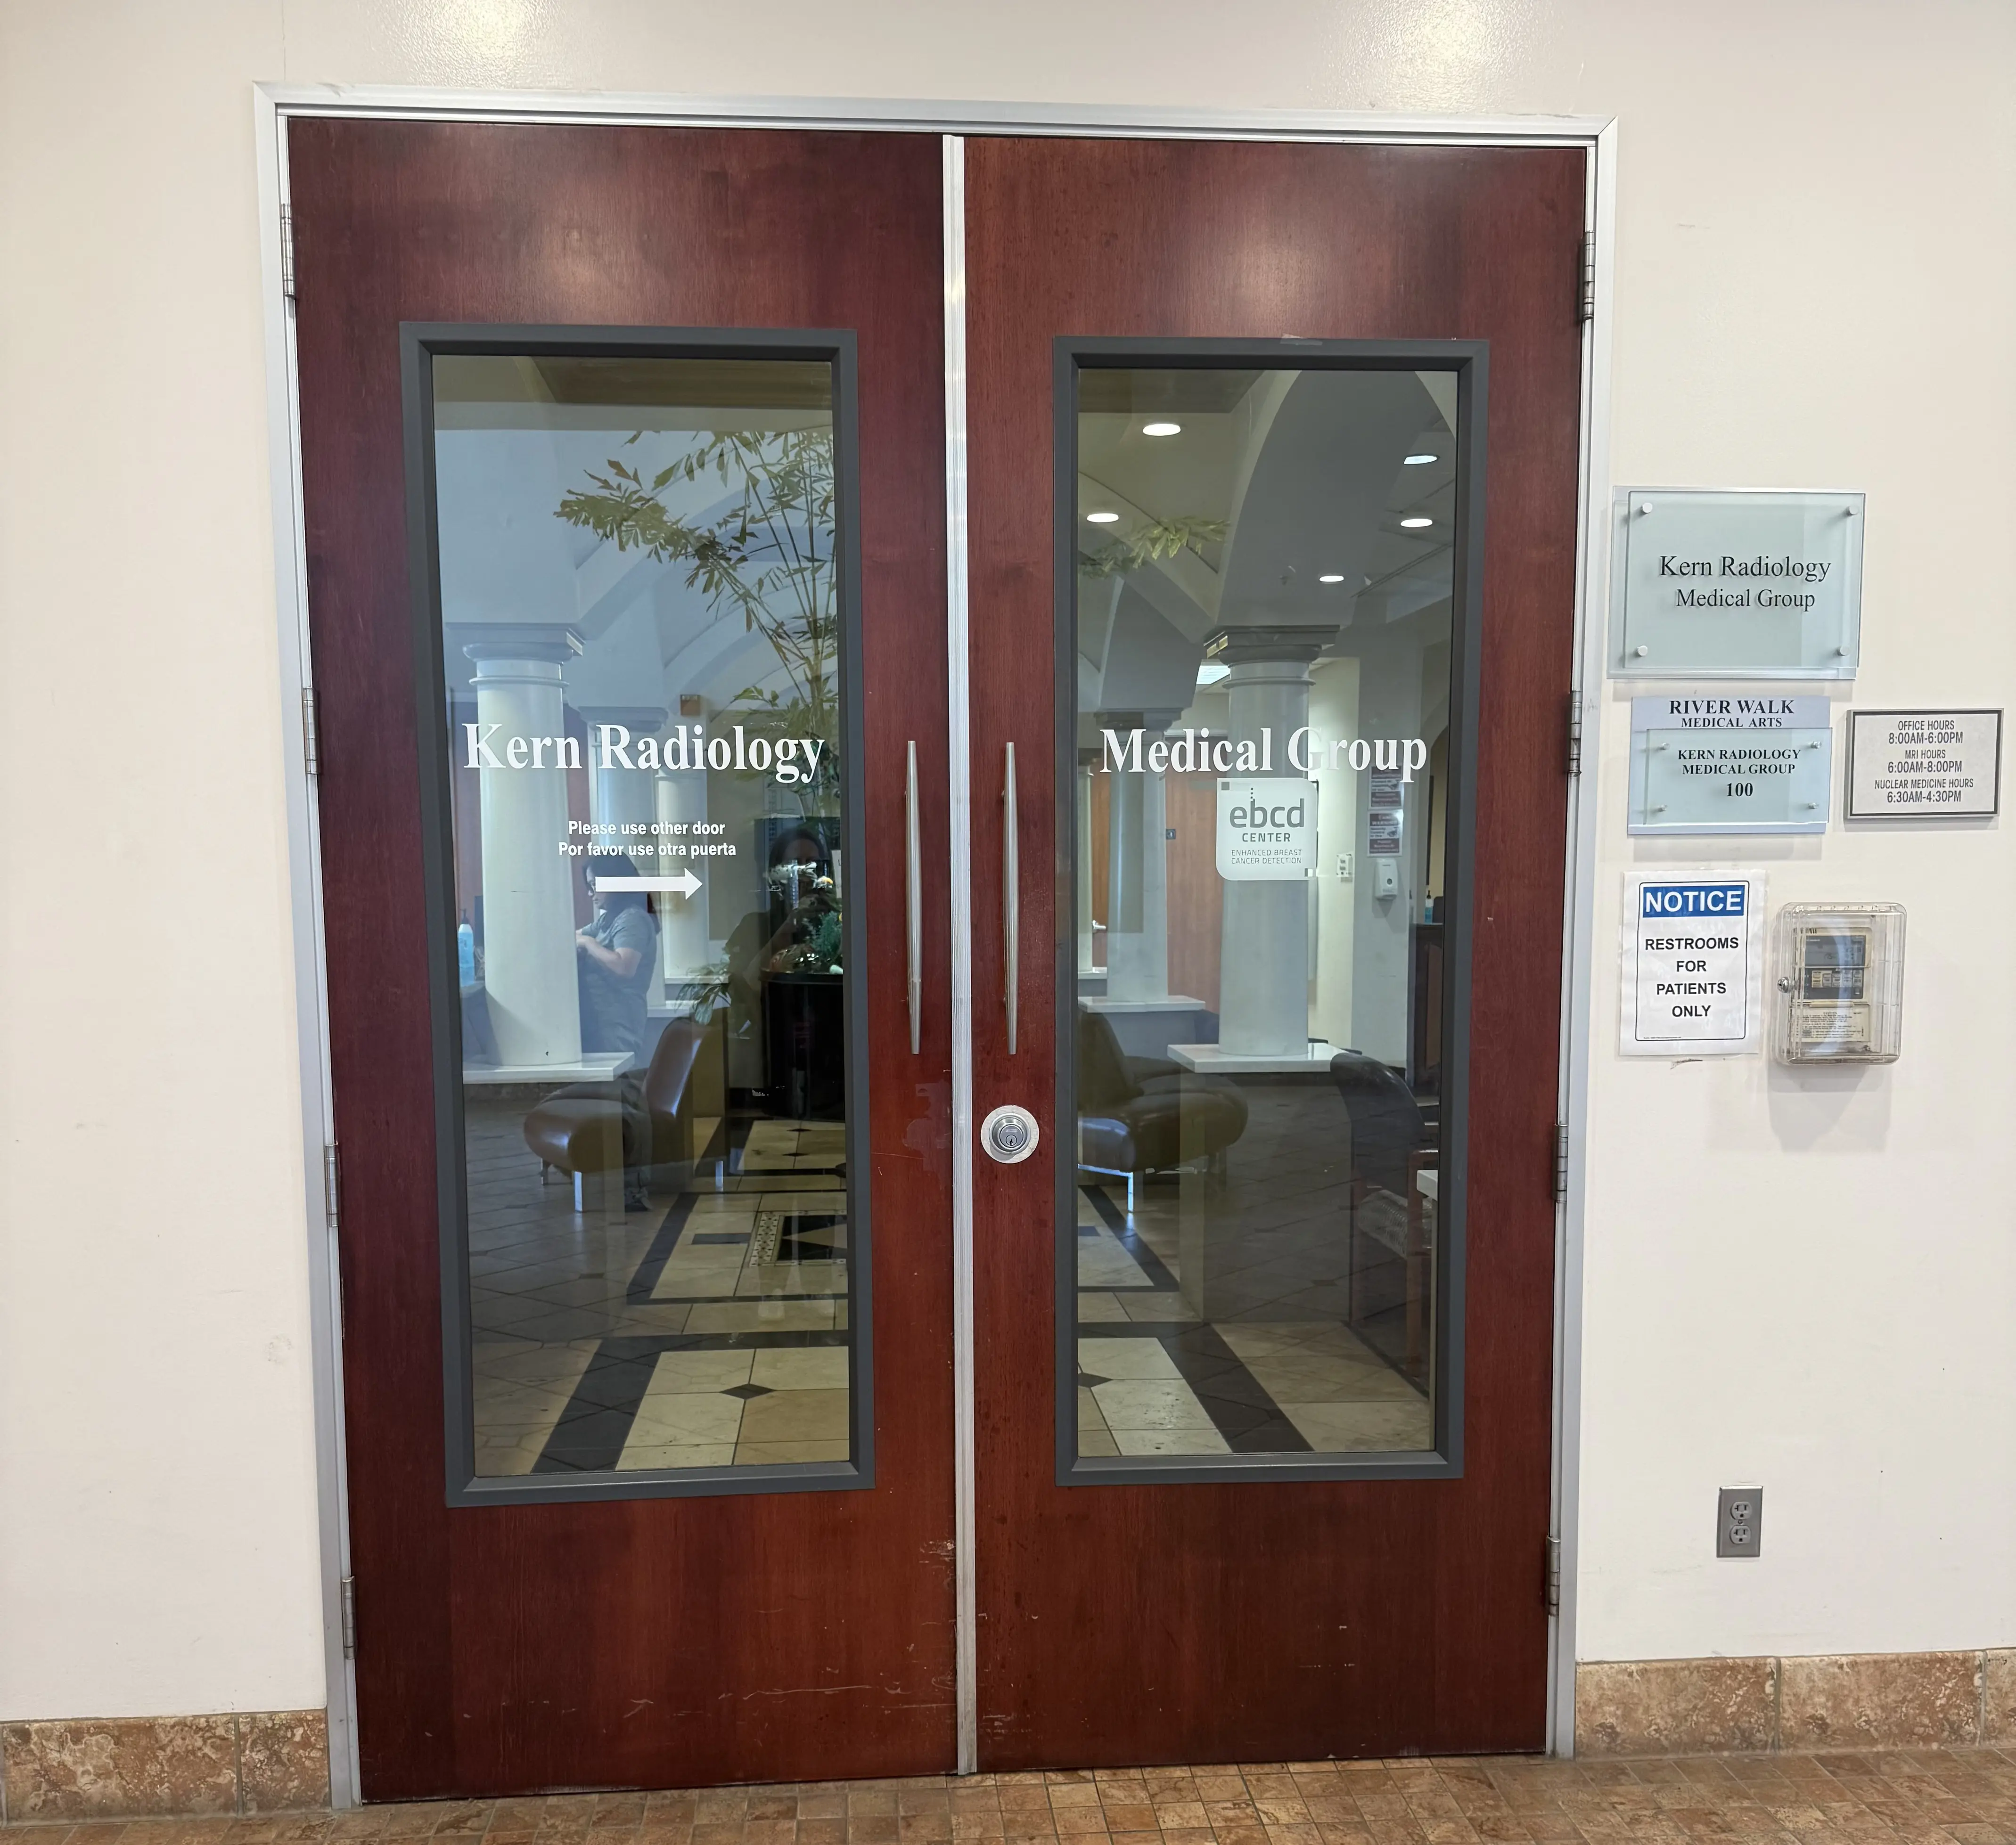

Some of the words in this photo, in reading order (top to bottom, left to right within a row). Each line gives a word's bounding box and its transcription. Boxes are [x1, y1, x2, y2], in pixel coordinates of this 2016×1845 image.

[1659, 556, 1713, 576] Kern
[1720, 555, 1831, 582] Radiology
[1676, 588, 1751, 607] Medical
[1757, 589, 1815, 612] Group
[1670, 700, 1731, 714] RIVER
[1737, 700, 1795, 714] WALK
[1681, 718, 1744, 727] MEDICAL
[1748, 718, 1782, 727] ARTS
[1898, 720, 1925, 731] OFFICE
[1927, 720, 1954, 730] HOURS
[1888, 732, 1963, 744] 8:00AM-6:00PM
[462, 723, 582, 769] Kern
[596, 725, 825, 783] Radiology
[1099, 727, 1273, 773] Medical
[1288, 726, 1426, 783] Group
[1678, 750, 1715, 760] KERN
[1720, 749, 1801, 759] RADIOLOGY
[1905, 750, 1918, 759] MRI
[1921, 749, 1946, 759] HOURS
[1683, 764, 1746, 775] MEDICAL
[1748, 764, 1795, 774] GROUP
[1888, 760, 1962, 773] 6:00AM-8:00PM
[1727, 783, 1753, 797] 100
[1875, 779, 1909, 789] NUCLEAR
[1910, 778, 1946, 789] MEDICINE
[1949, 778, 1974, 788] HOURS
[1887, 790, 1961, 803] 6:30AM-4:30PM
[1229, 798, 1305, 828] ebcd
[568, 820, 617, 835] Please
[621, 824, 647, 835] use
[651, 821, 688, 835] other
[692, 821, 725, 835] door
[1242, 833, 1290, 842] CENTER
[558, 841, 583, 856] Por
[587, 842, 624, 856] favor
[628, 845, 654, 856] use
[658, 843, 687, 856] otra
[691, 842, 736, 859] puerta
[1646, 890, 1742, 912] NOTICE
[1645, 937, 1739, 950] RESTROOMS
[1676, 960, 1707, 972] FOR
[1656, 982, 1726, 995] PATIENTS
[1672, 1005, 1711, 1017] ONLY
